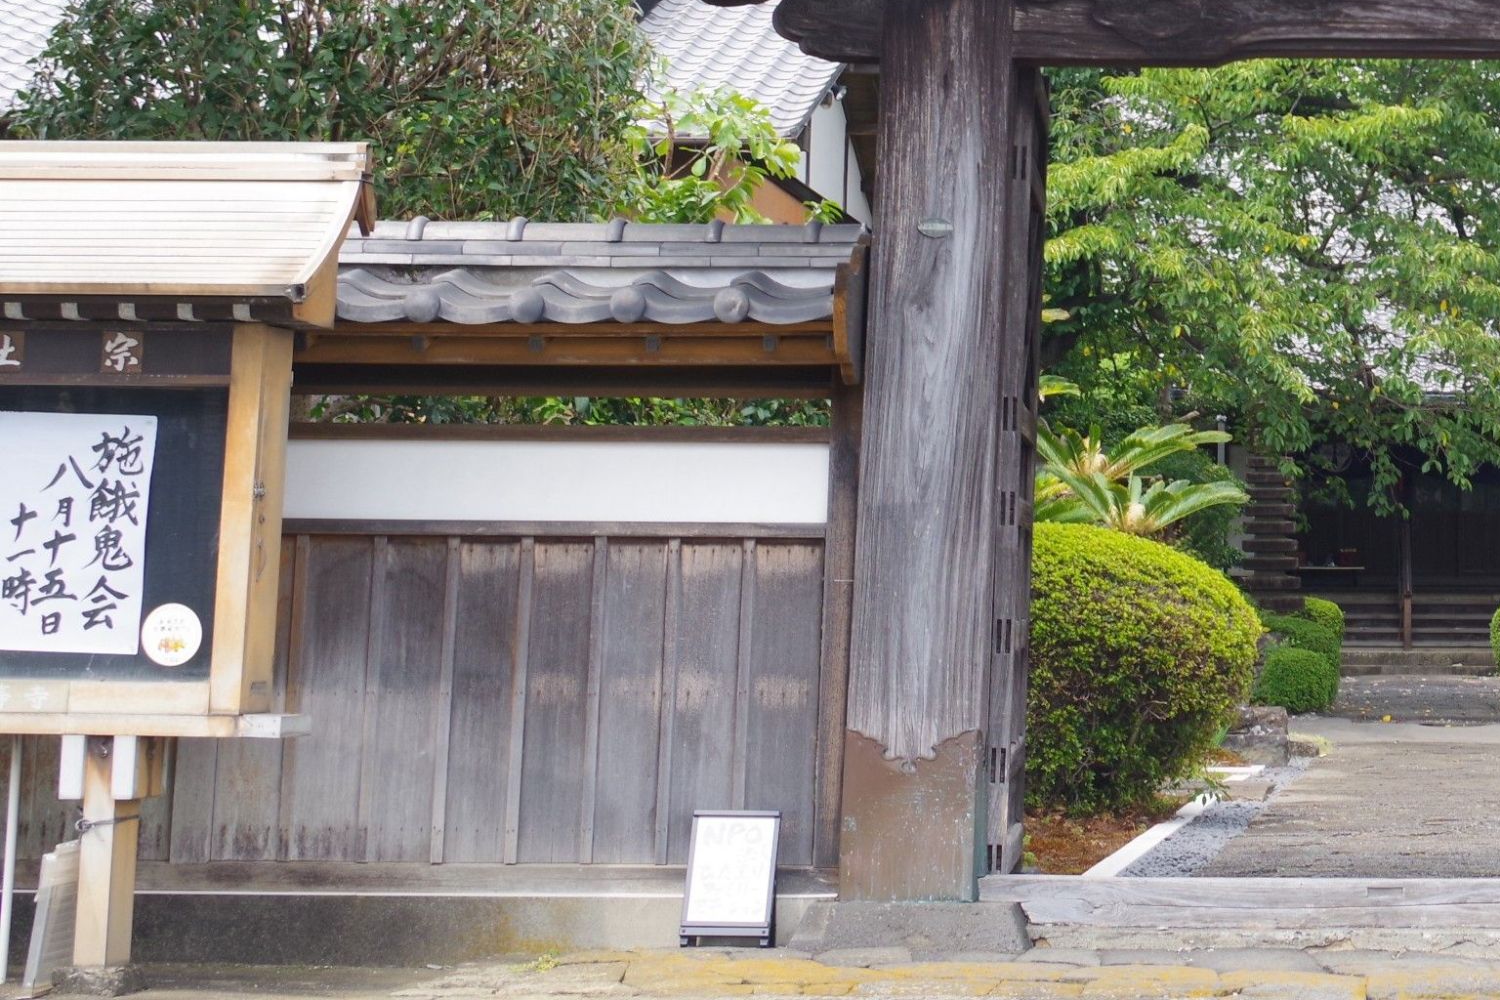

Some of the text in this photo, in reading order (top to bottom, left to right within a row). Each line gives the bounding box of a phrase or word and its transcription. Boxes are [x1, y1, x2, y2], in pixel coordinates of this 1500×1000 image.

[1, 502, 38, 616] 十一時
[30, 455, 94, 636] 八月十五日
[81, 426, 144, 630] 施餓鬼会
